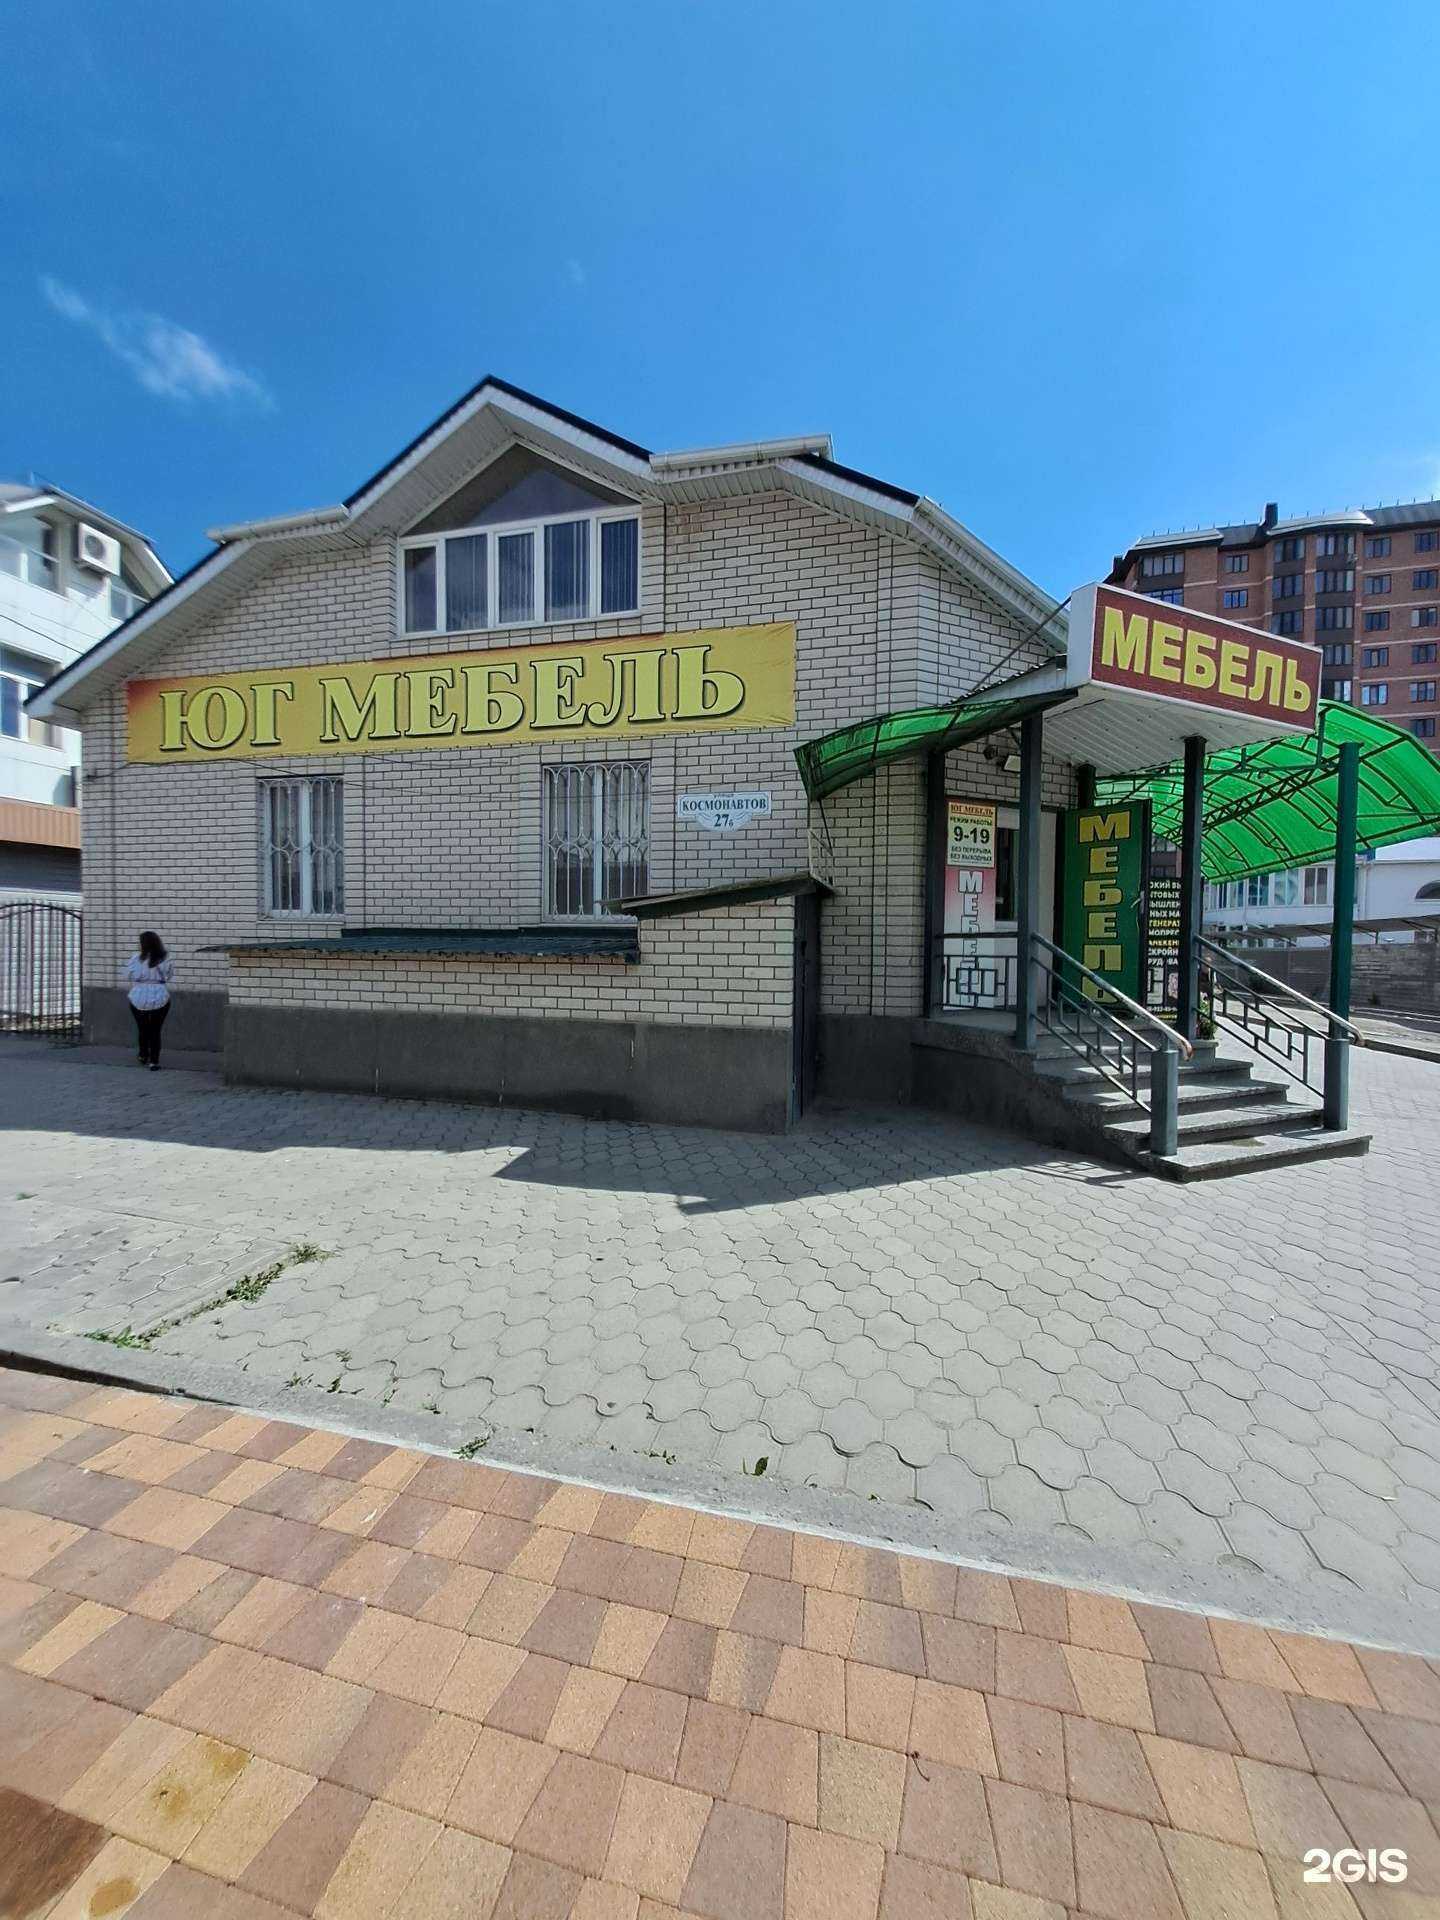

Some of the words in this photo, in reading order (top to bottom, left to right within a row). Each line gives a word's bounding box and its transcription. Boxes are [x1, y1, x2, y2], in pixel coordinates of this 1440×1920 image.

[159, 682, 293, 751] ЮГ
[319, 645, 746, 743] МЕБЕЛЬ
[1101, 606, 1311, 712] МЕБЕЛЬ
[682, 798, 767, 812] КОСМОНАВТОВ
[954, 826, 990, 844] 9-19
[1079, 811, 1131, 1004] МЕБЕЛЬ
